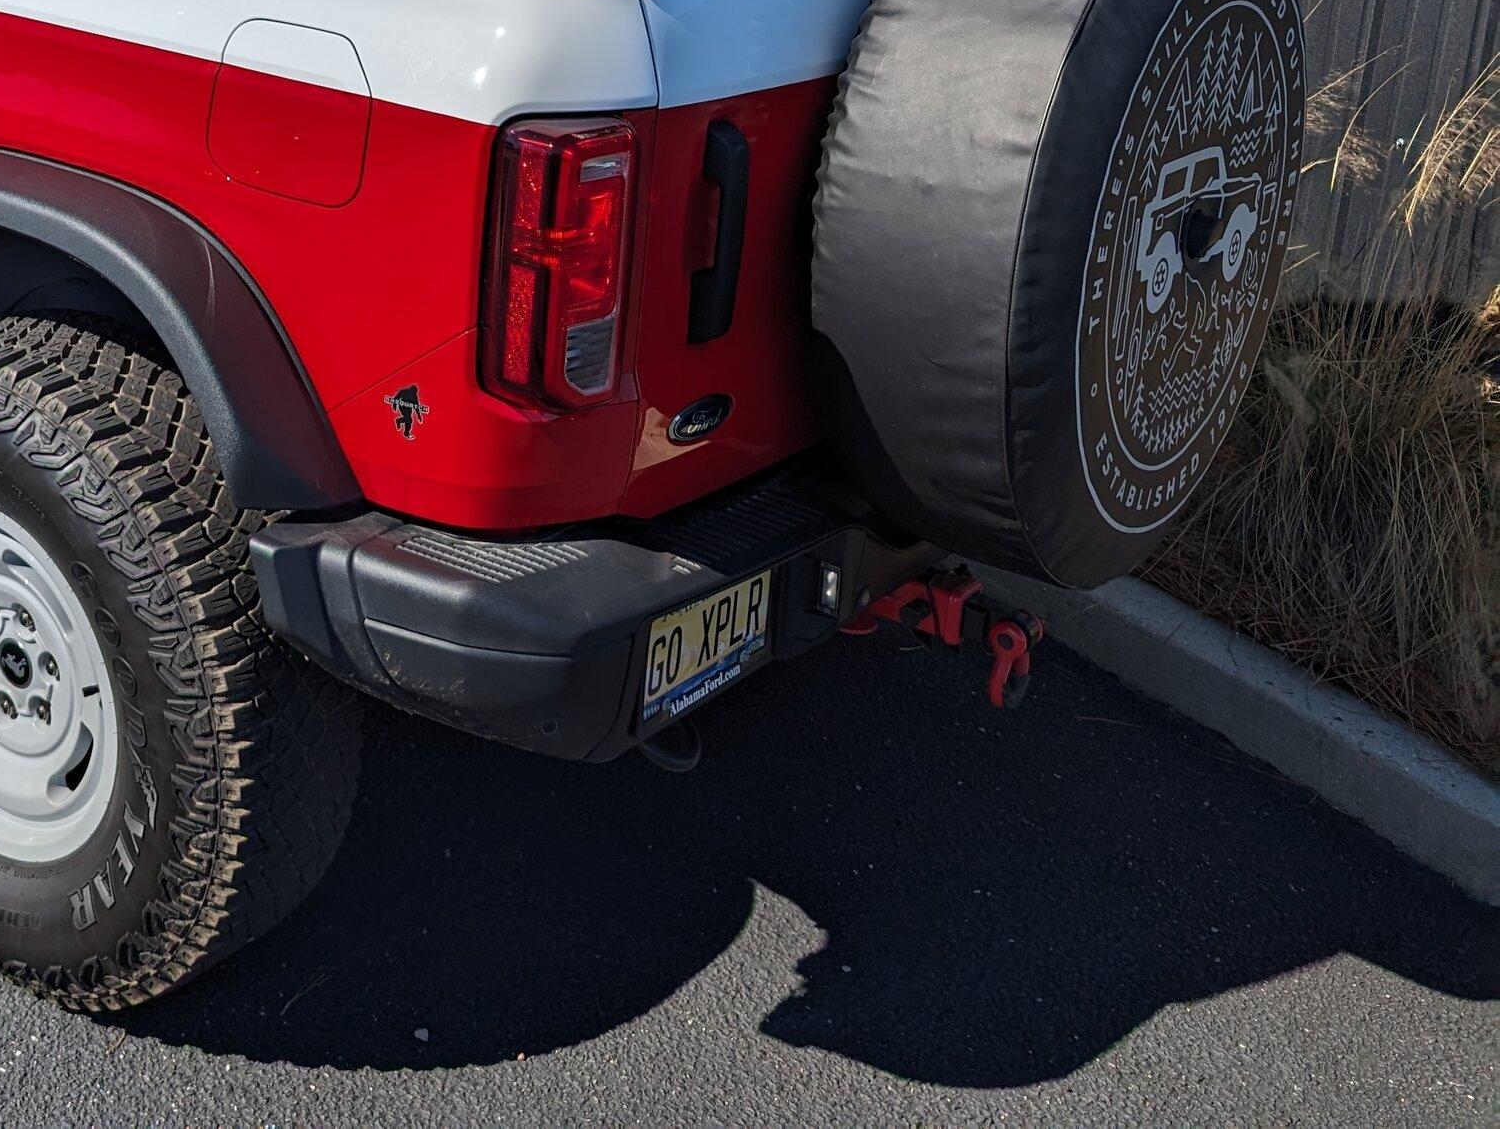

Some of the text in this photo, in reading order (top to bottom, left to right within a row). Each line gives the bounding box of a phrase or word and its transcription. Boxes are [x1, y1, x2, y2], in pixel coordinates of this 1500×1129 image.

[1141, 9, 1193, 108] STILL
[1285, 26, 1301, 91] OUT
[1276, 110, 1301, 246] THERE
[1095, 360, 1248, 511] ESTABLISHED 1966
[647, 625, 683, 697] GO
[696, 576, 764, 668] XPLR
[669, 664, 741, 718] AlabamaFord.com
